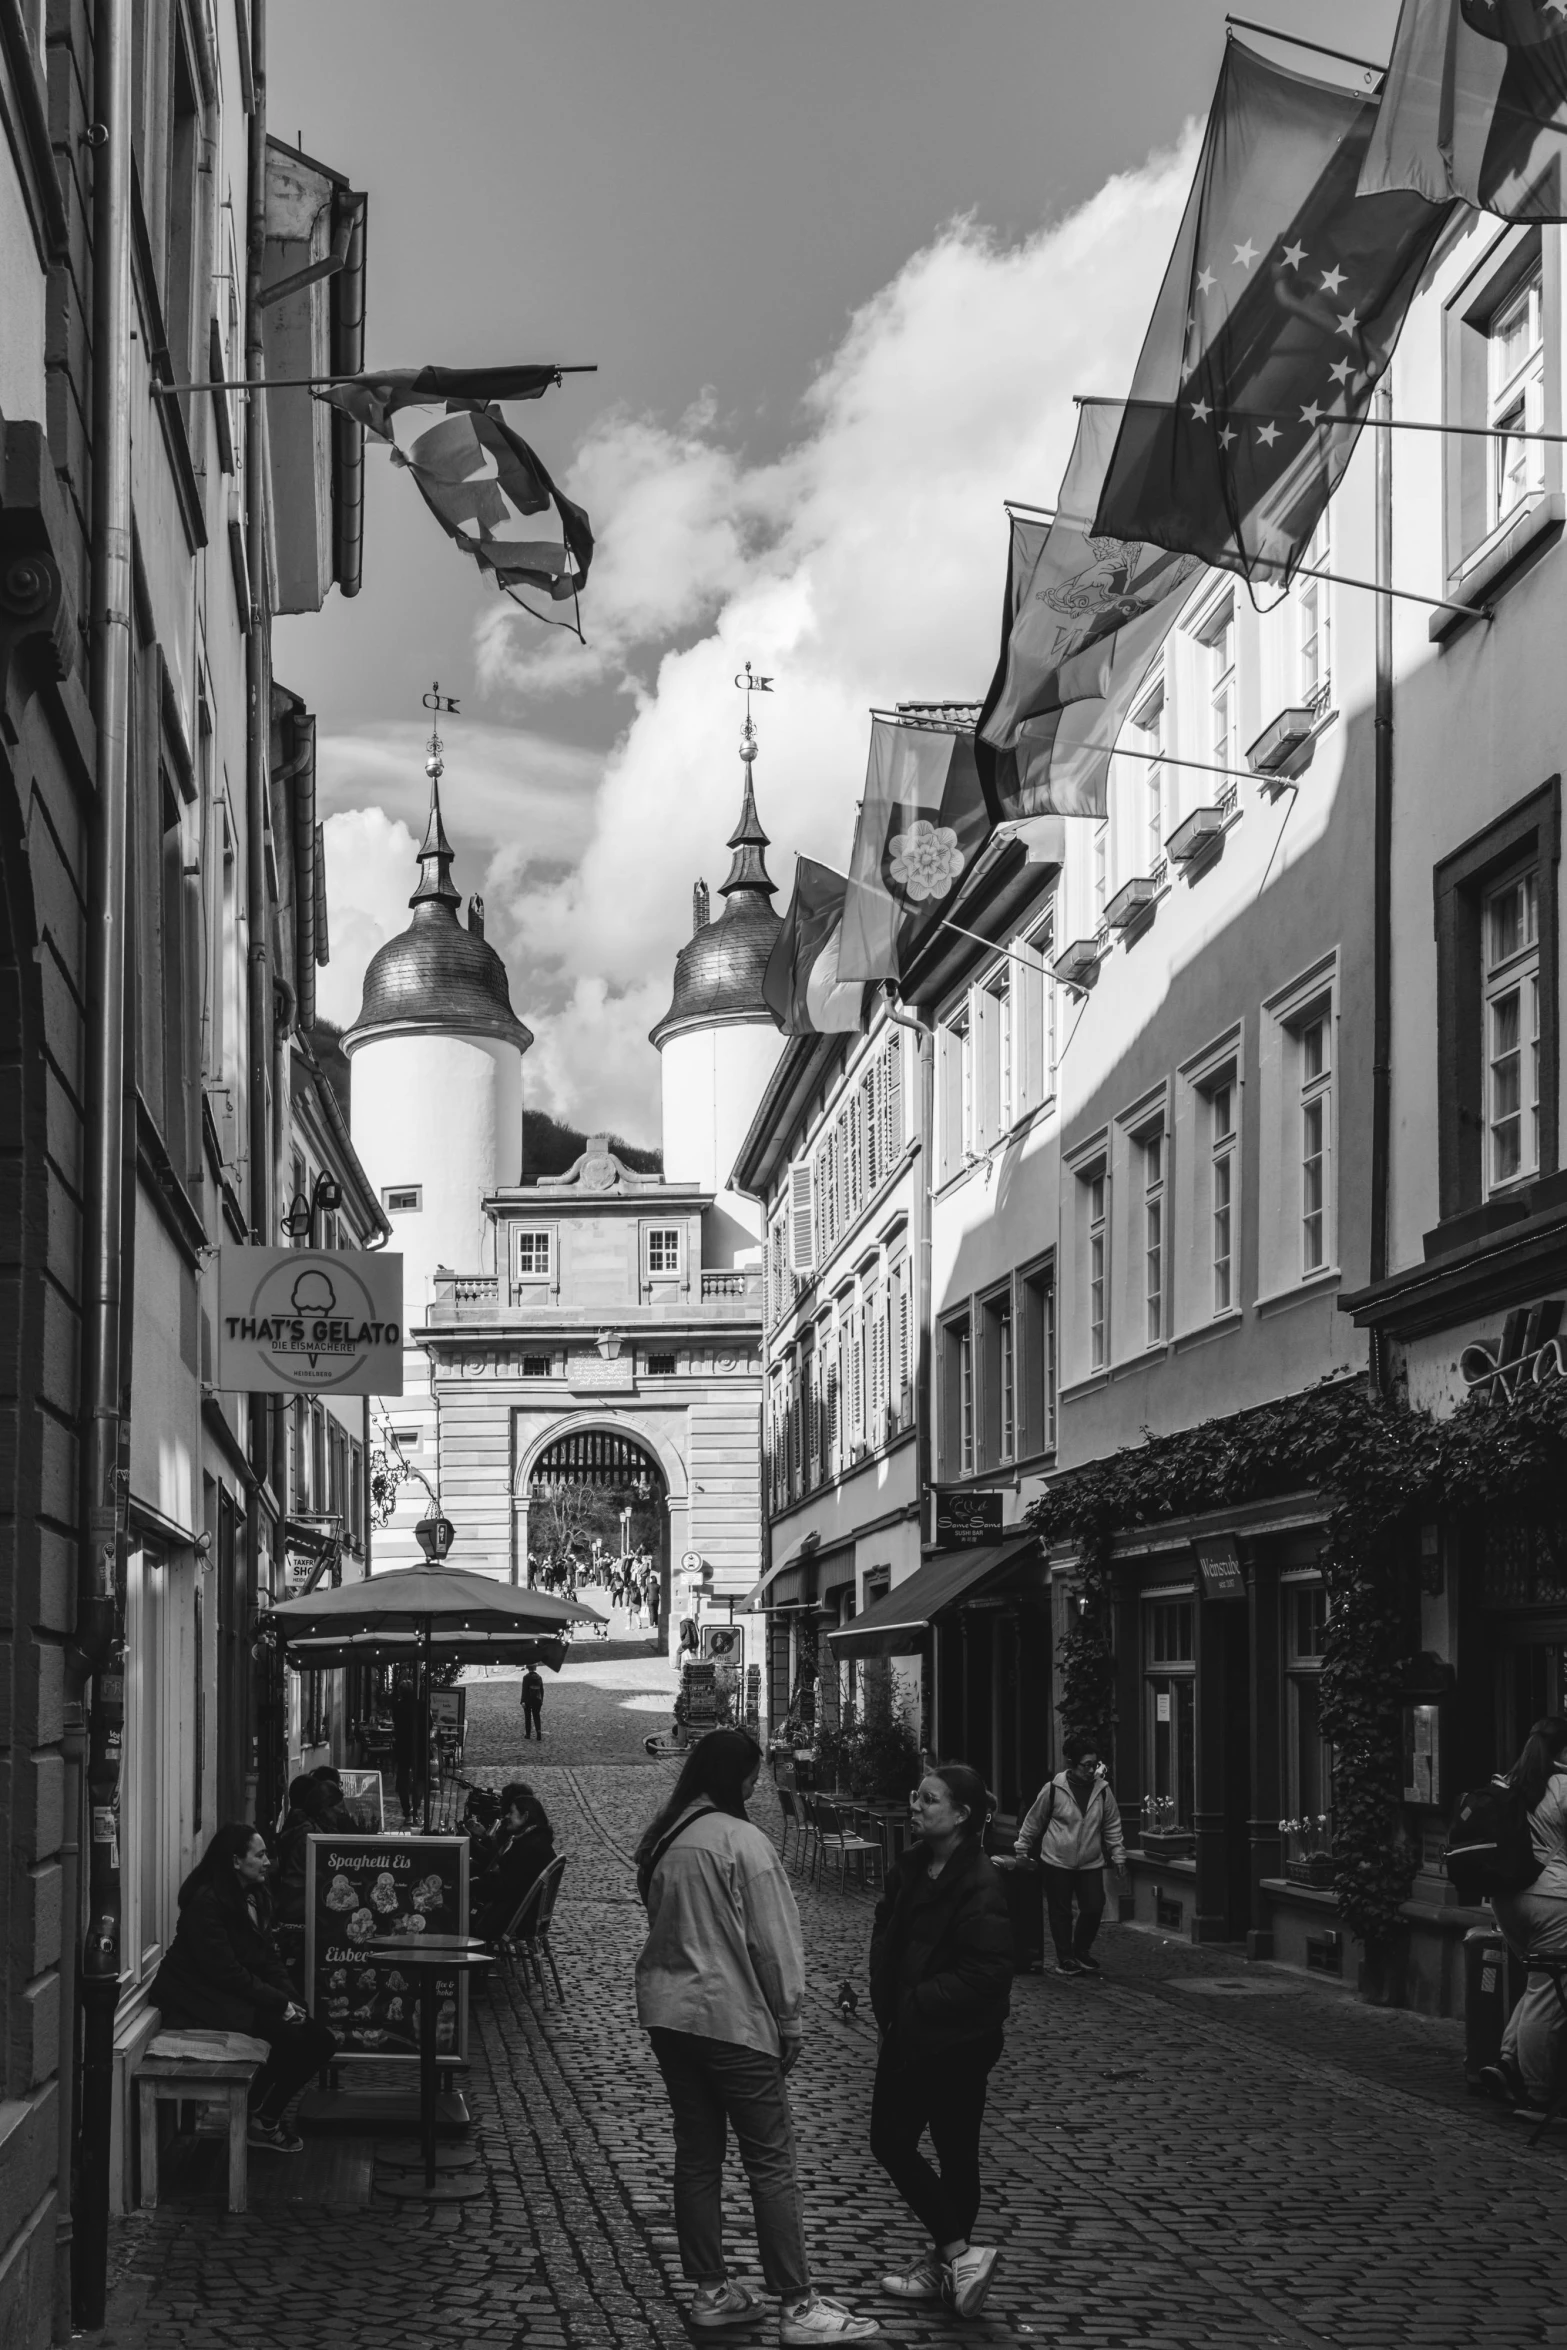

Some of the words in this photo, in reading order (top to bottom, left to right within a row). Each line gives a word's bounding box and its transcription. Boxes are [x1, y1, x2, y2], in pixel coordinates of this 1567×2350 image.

[226, 1317, 305, 1341] THAT'S
[312, 1321, 400, 1344] GELATO
[271, 1341, 288, 1350] DIE
[290, 1342, 356, 1352] EISMACHEREI
[293, 1566, 313, 1576] SH
[1200, 1554, 1241, 1578] Weinstube
[328, 1853, 391, 1871] Spaghetti
[392, 1855, 411, 1869] Eis
[325, 1946, 374, 1962] Eisbec
